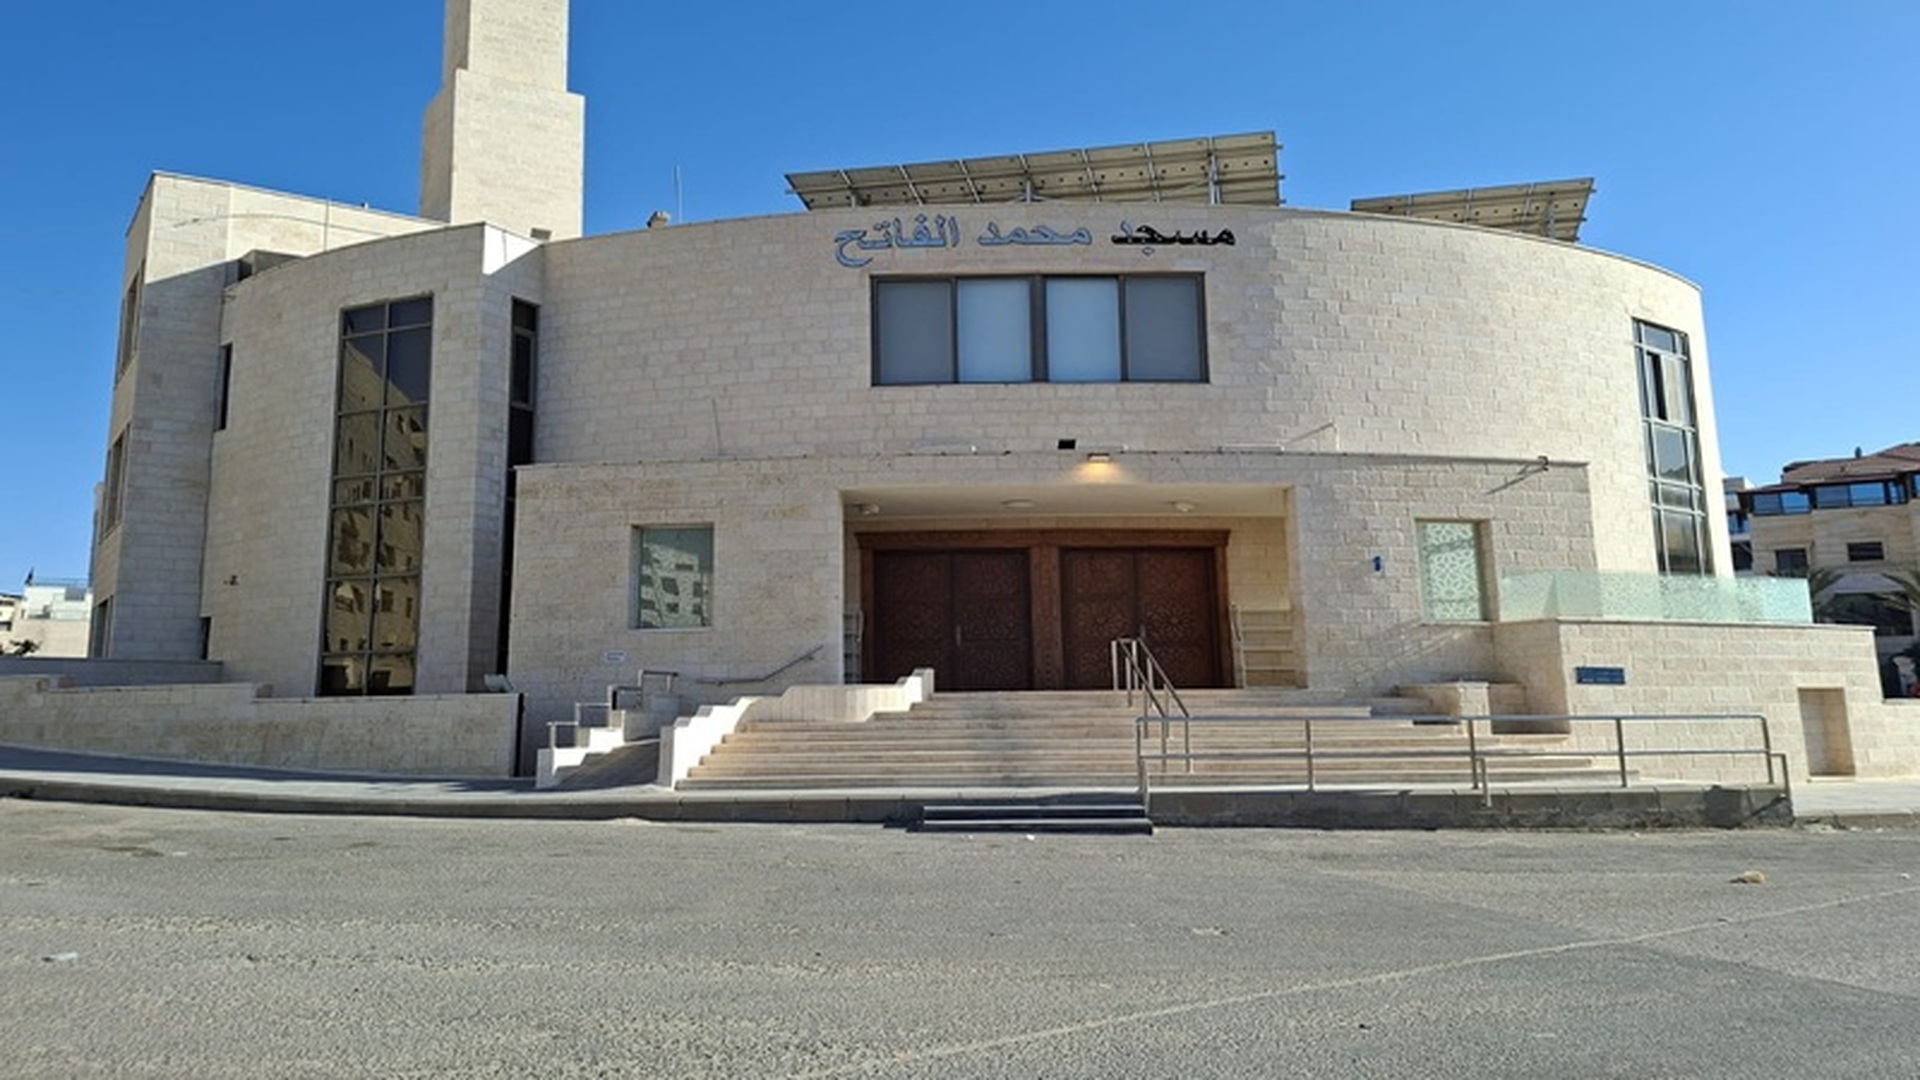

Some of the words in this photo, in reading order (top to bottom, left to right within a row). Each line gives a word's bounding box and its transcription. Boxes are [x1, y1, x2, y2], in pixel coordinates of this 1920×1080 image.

[833, 213, 960, 269] الفاتح
[976, 220, 1093, 247] محمد
[1110, 217, 1236, 257] مسجد
